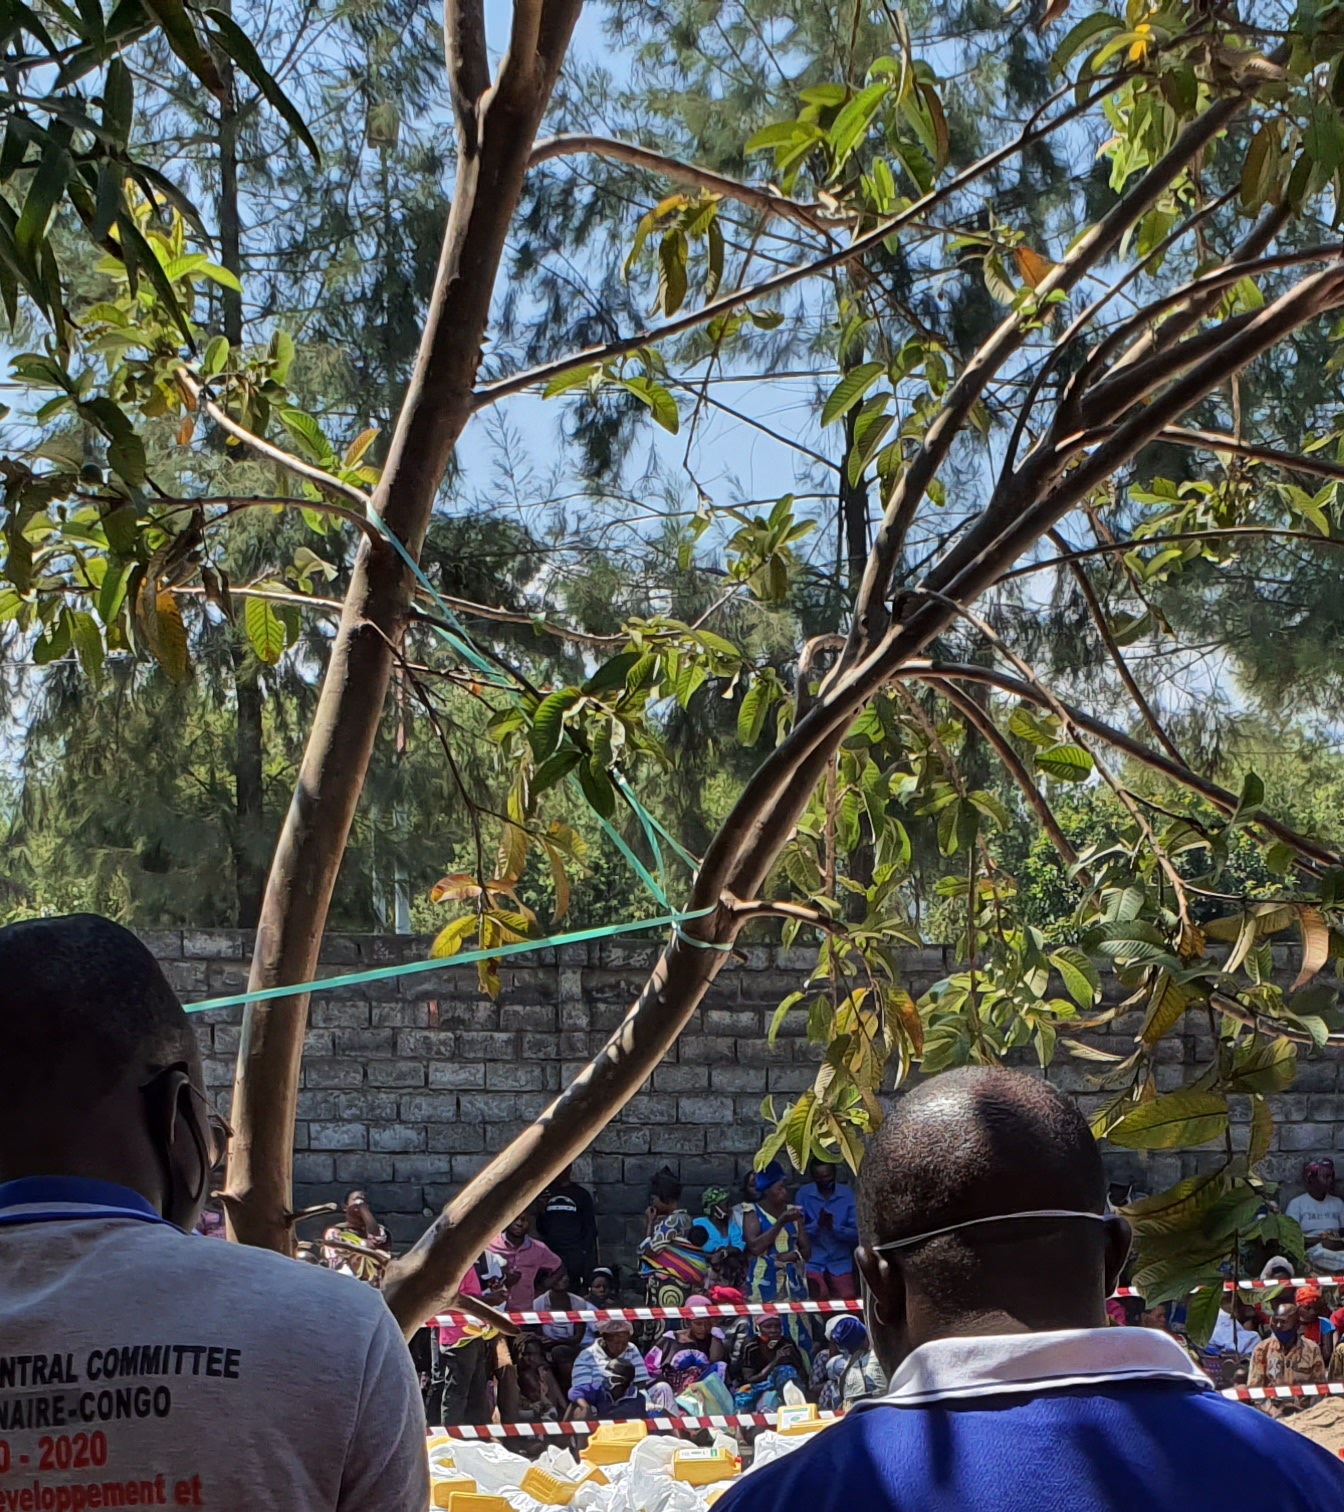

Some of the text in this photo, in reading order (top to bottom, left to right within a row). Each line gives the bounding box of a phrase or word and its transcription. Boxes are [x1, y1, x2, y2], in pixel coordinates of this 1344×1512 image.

[86, 1345, 241, 1380] COMMITTEE
[39, 1431, 107, 1471] 2020
[174, 1474, 203, 1506] et
